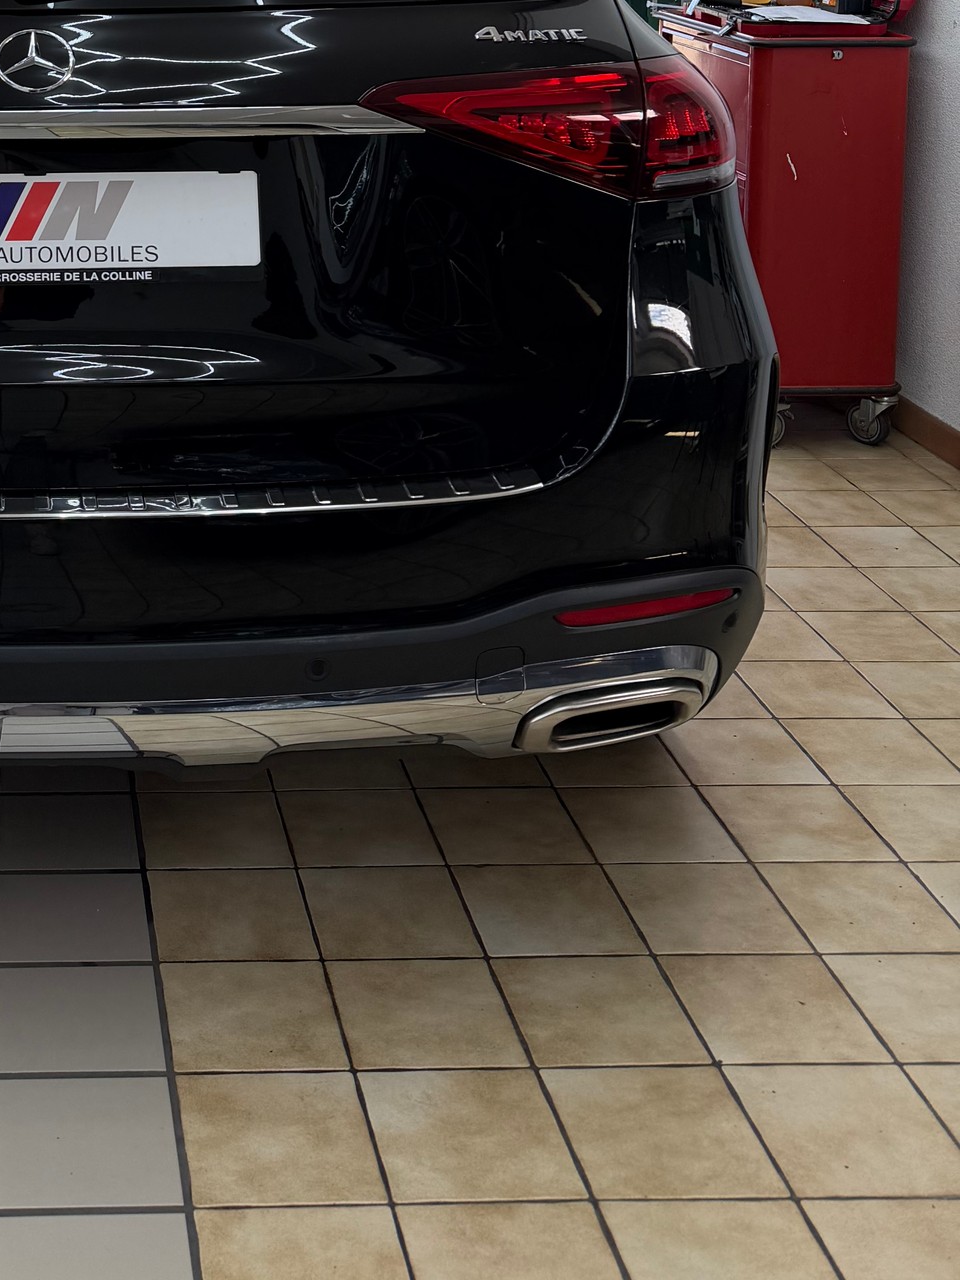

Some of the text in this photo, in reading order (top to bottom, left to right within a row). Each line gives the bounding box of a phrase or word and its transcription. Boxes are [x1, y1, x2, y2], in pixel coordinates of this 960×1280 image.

[474, 25, 588, 43] 4MATIC
[64, 272, 80, 282] DE
[83, 271, 99, 281] LA
[101, 270, 153, 281] COLLINE
